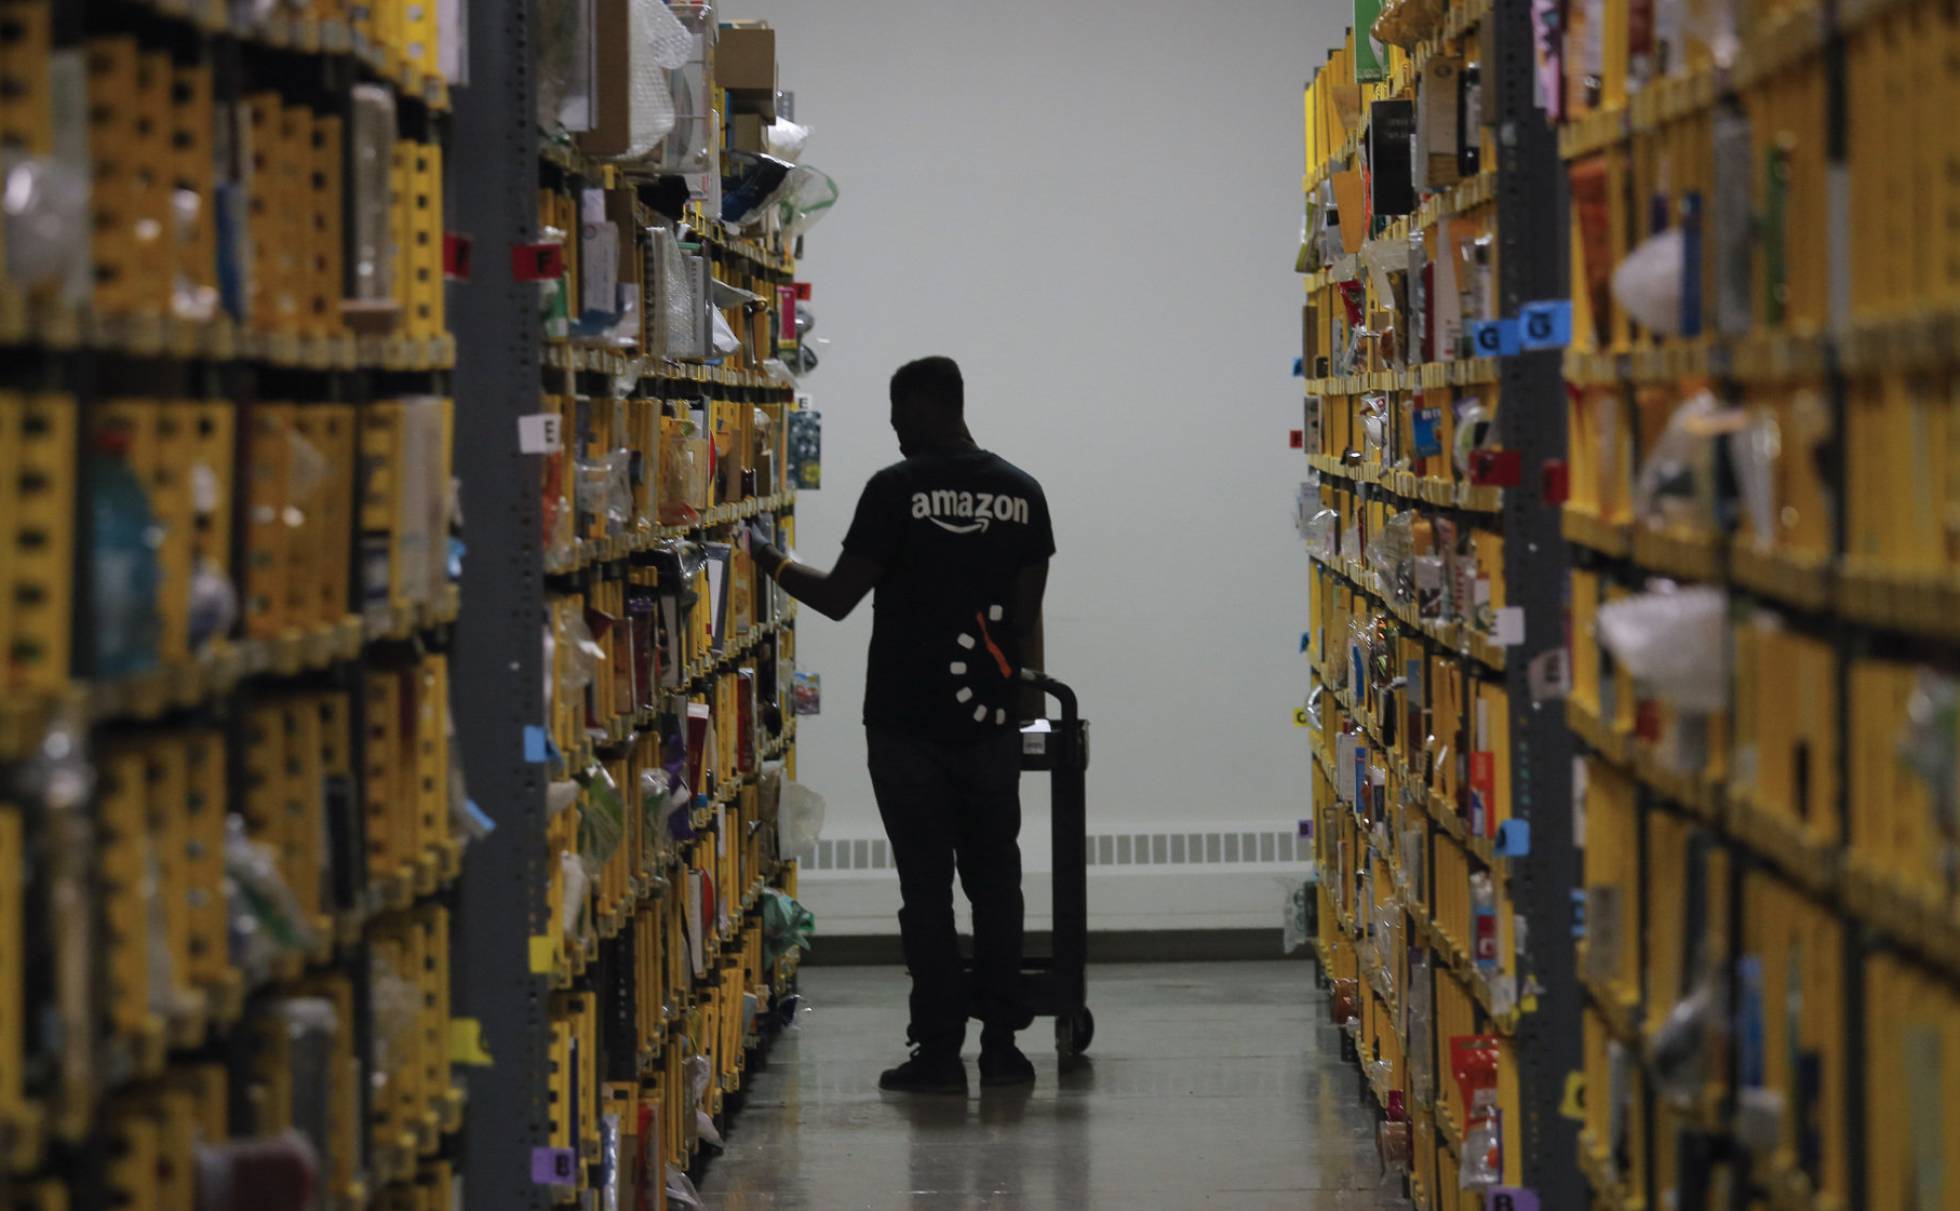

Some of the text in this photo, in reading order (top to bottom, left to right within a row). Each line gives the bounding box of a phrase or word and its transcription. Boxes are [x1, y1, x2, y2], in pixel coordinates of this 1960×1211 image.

[536, 250, 555, 274] F
[1527, 311, 1552, 341] G
[1479, 328, 1500, 352] G
[798, 397, 808, 411] E
[544, 420, 555, 444] E
[911, 489, 1029, 525] amazon
[1296, 711, 1307, 725] C
